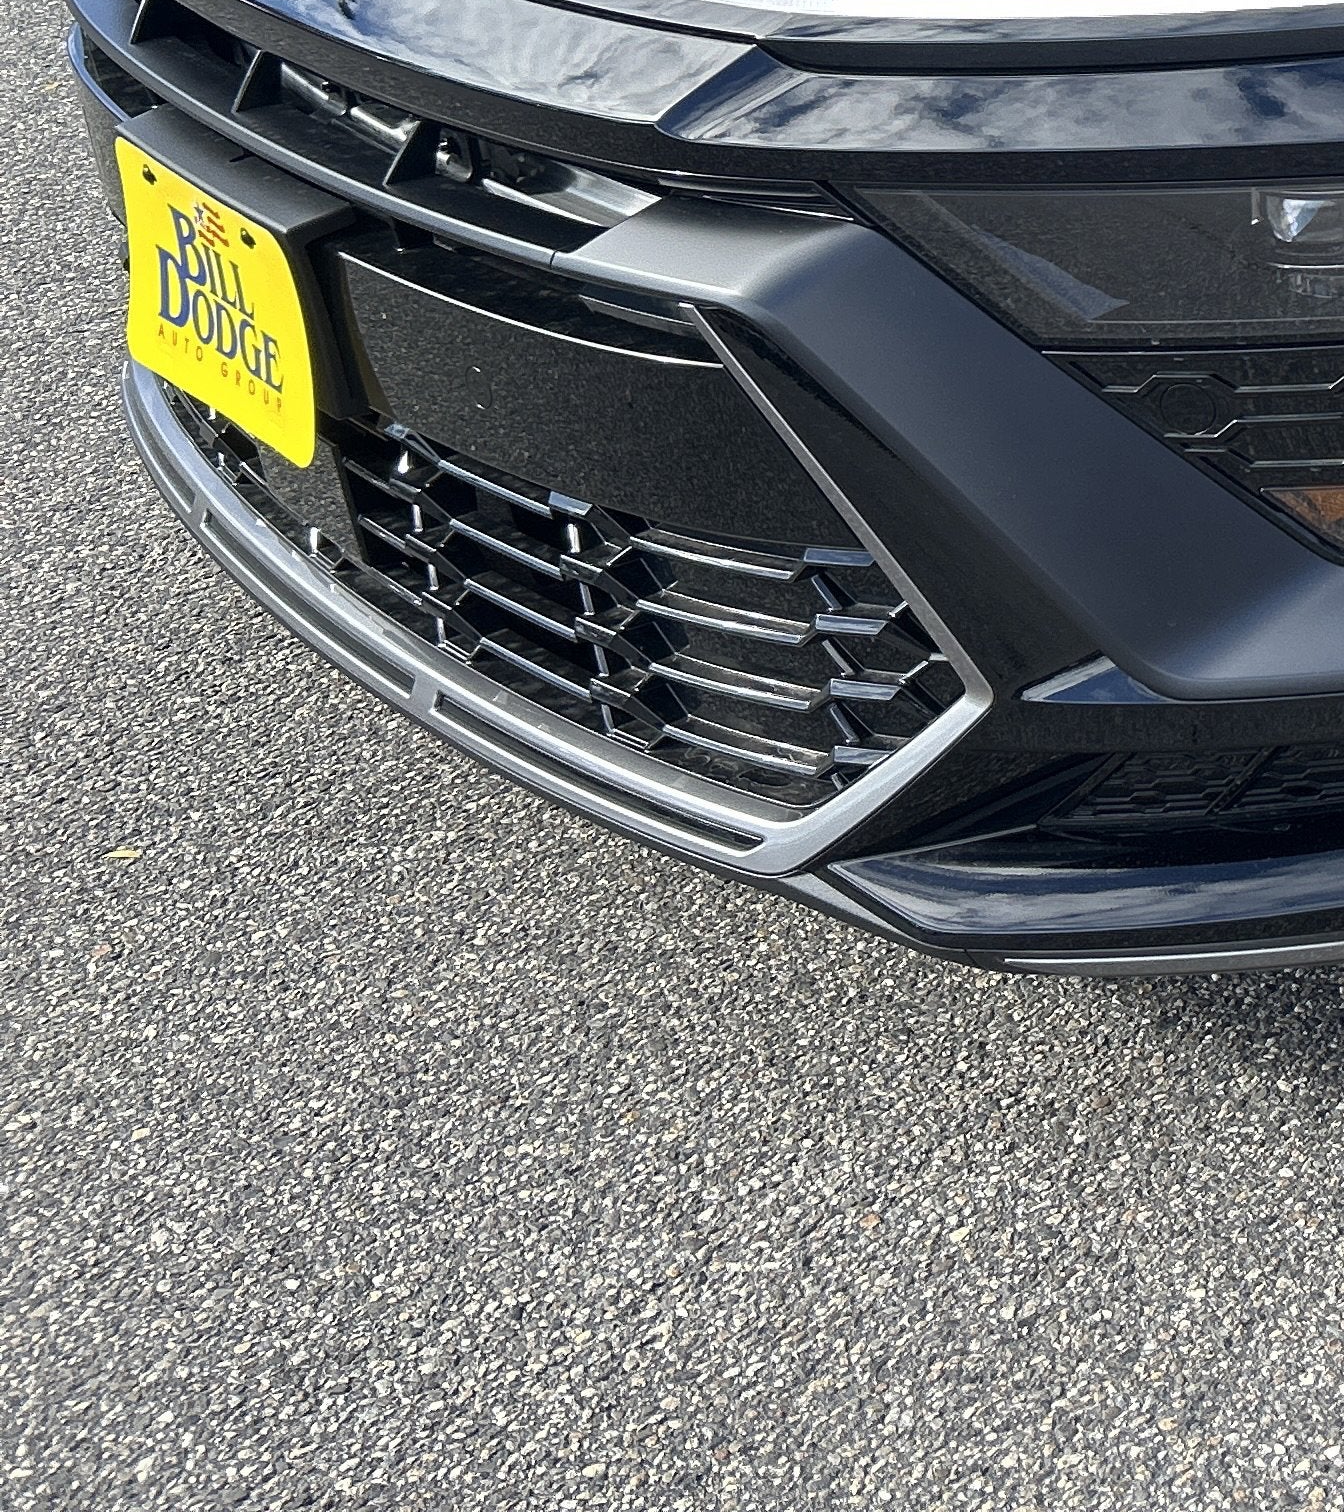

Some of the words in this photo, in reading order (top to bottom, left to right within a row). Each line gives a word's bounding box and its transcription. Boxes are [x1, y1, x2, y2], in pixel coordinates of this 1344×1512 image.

[155, 243, 285, 395] DODGE
[167, 203, 255, 321] BILL
[158, 322, 203, 362] AUTO
[220, 361, 282, 413] GROUP
